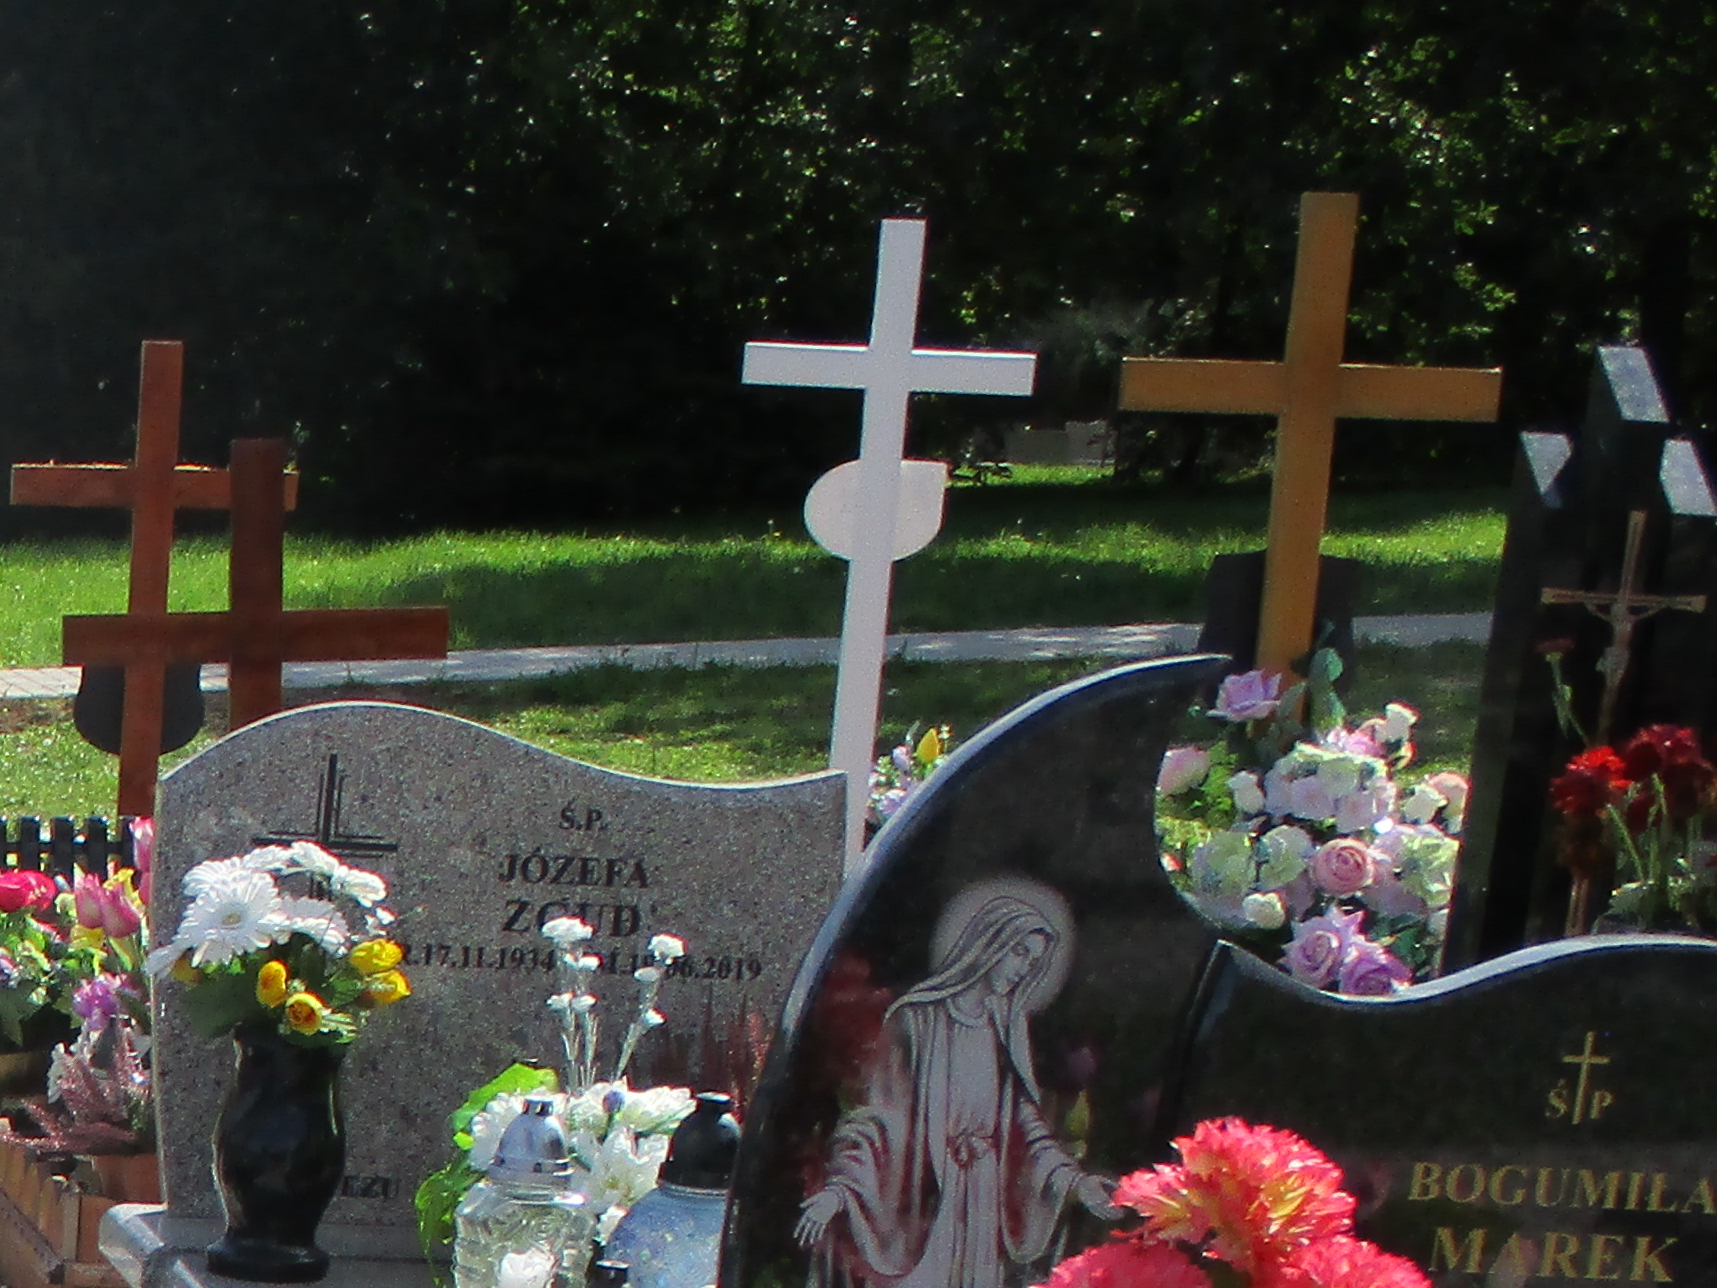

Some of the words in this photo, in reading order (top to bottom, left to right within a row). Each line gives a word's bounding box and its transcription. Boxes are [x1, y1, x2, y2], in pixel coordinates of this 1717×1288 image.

[498, 847, 650, 889] JÓZEFA
[1590, 1089, 1614, 1120] P
[1428, 1226, 1679, 1283] MAREK
